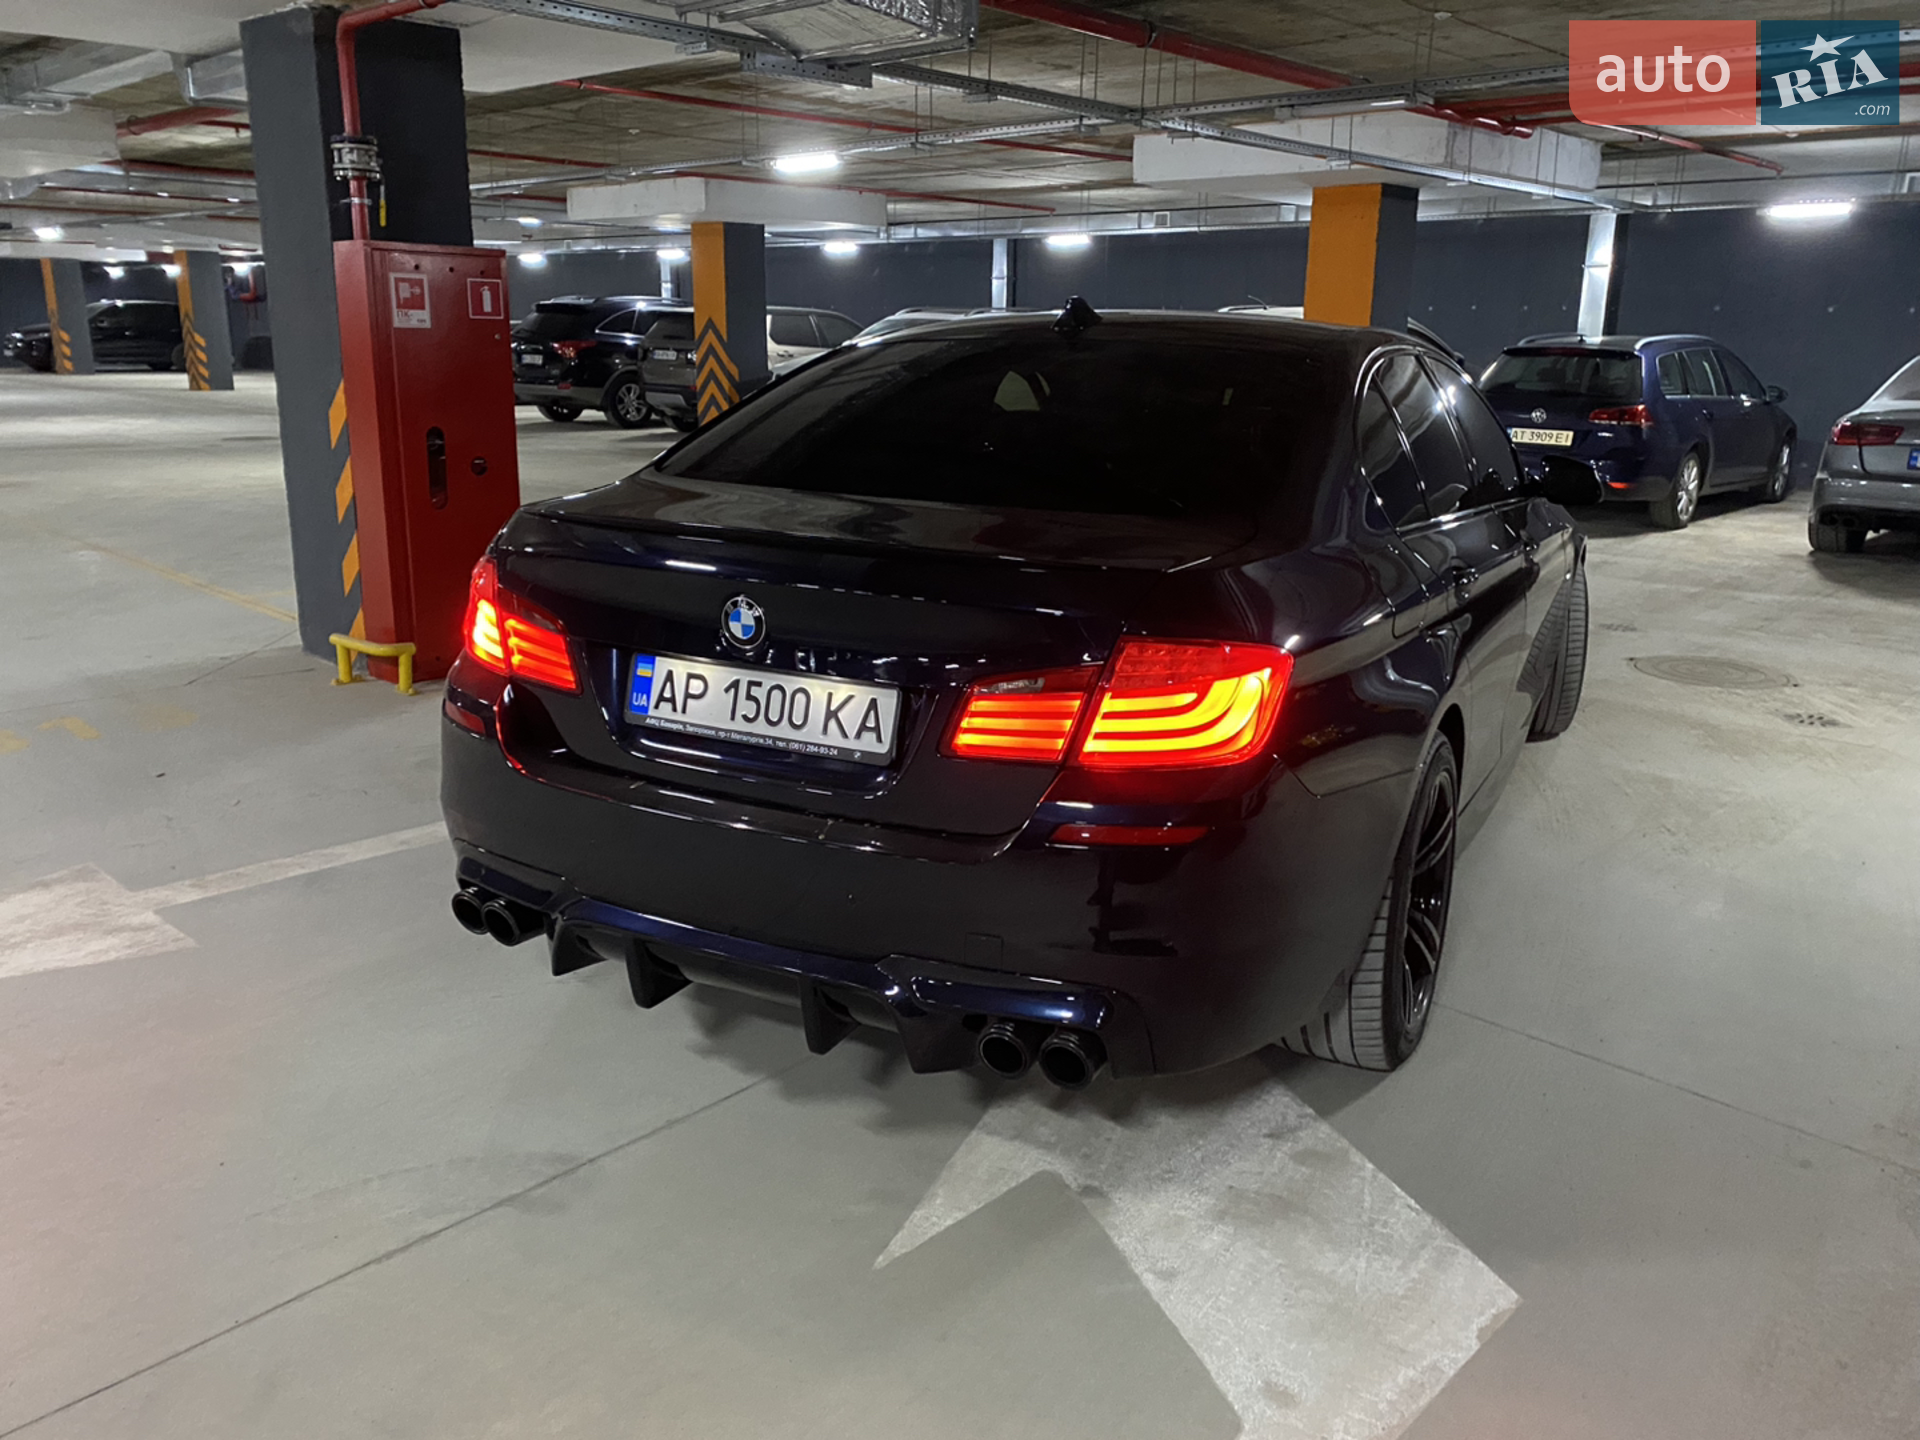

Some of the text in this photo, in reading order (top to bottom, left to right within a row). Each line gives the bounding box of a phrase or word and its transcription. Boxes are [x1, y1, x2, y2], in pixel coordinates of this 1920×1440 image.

[1511, 430, 1570, 443] AT 3909 EI
[632, 691, 648, 707] UA
[653, 669, 883, 744] AP 1500 KA
